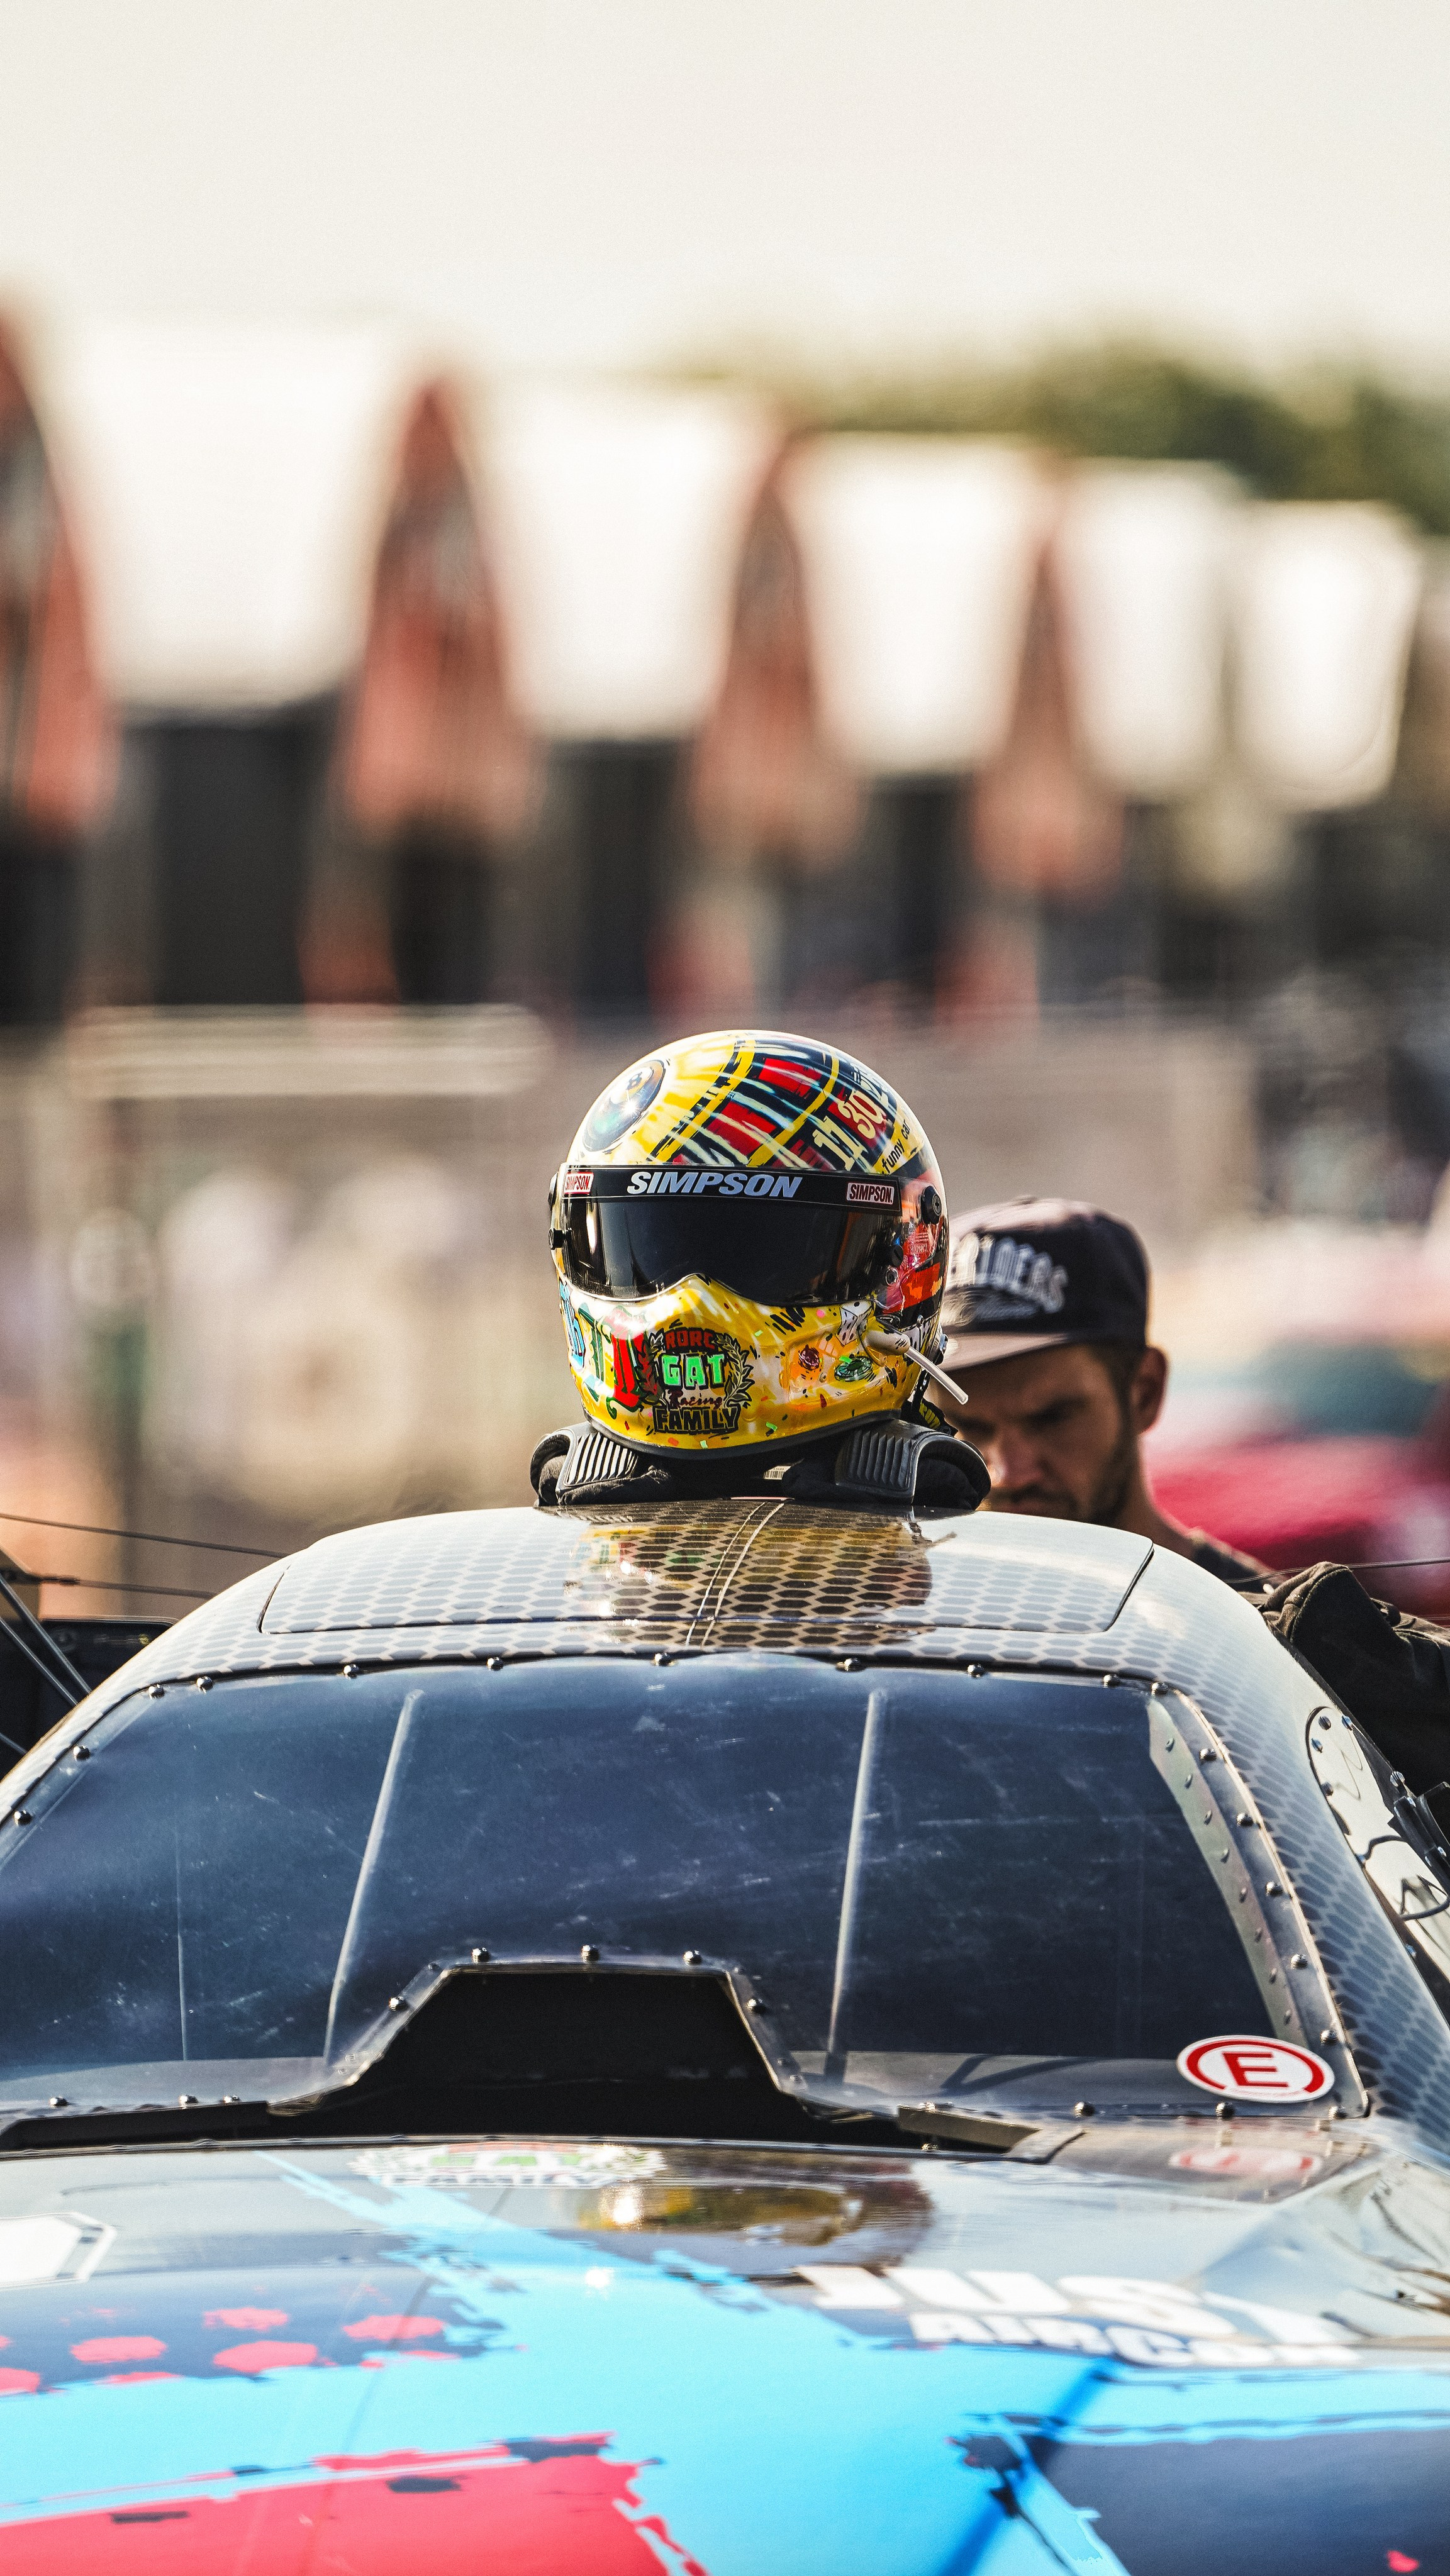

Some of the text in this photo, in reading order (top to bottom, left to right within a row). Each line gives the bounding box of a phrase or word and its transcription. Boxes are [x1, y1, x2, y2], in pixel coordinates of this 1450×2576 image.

[837, 1091, 884, 1139] 30
[812, 1115, 864, 1171] 11
[881, 1139, 905, 1174] funny
[901, 1119, 911, 1140] car
[627, 1172, 803, 1197] SIMPSON
[661, 1353, 725, 1388] GAT
[667, 1389, 723, 1409] Racing
[654, 1406, 739, 1433] FAMILY
[1222, 2051, 1289, 2087] E
[796, 2265, 1362, 2344] JUST
